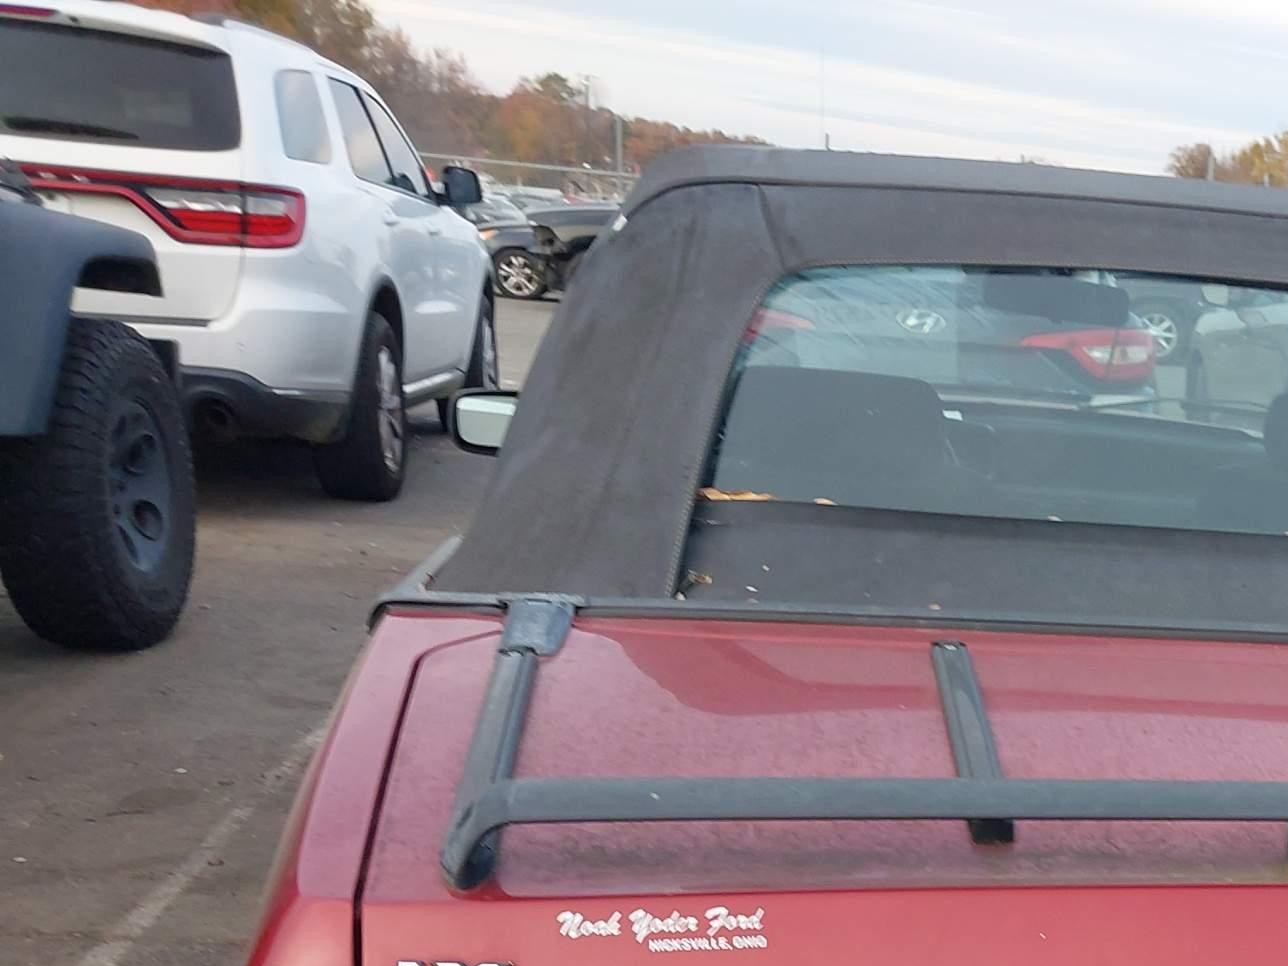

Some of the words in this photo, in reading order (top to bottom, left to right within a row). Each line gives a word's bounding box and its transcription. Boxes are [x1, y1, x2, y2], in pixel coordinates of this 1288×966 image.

[629, 909, 698, 943] Yoder
[705, 906, 764, 935] Ford
[733, 935, 767, 948] OHIO
